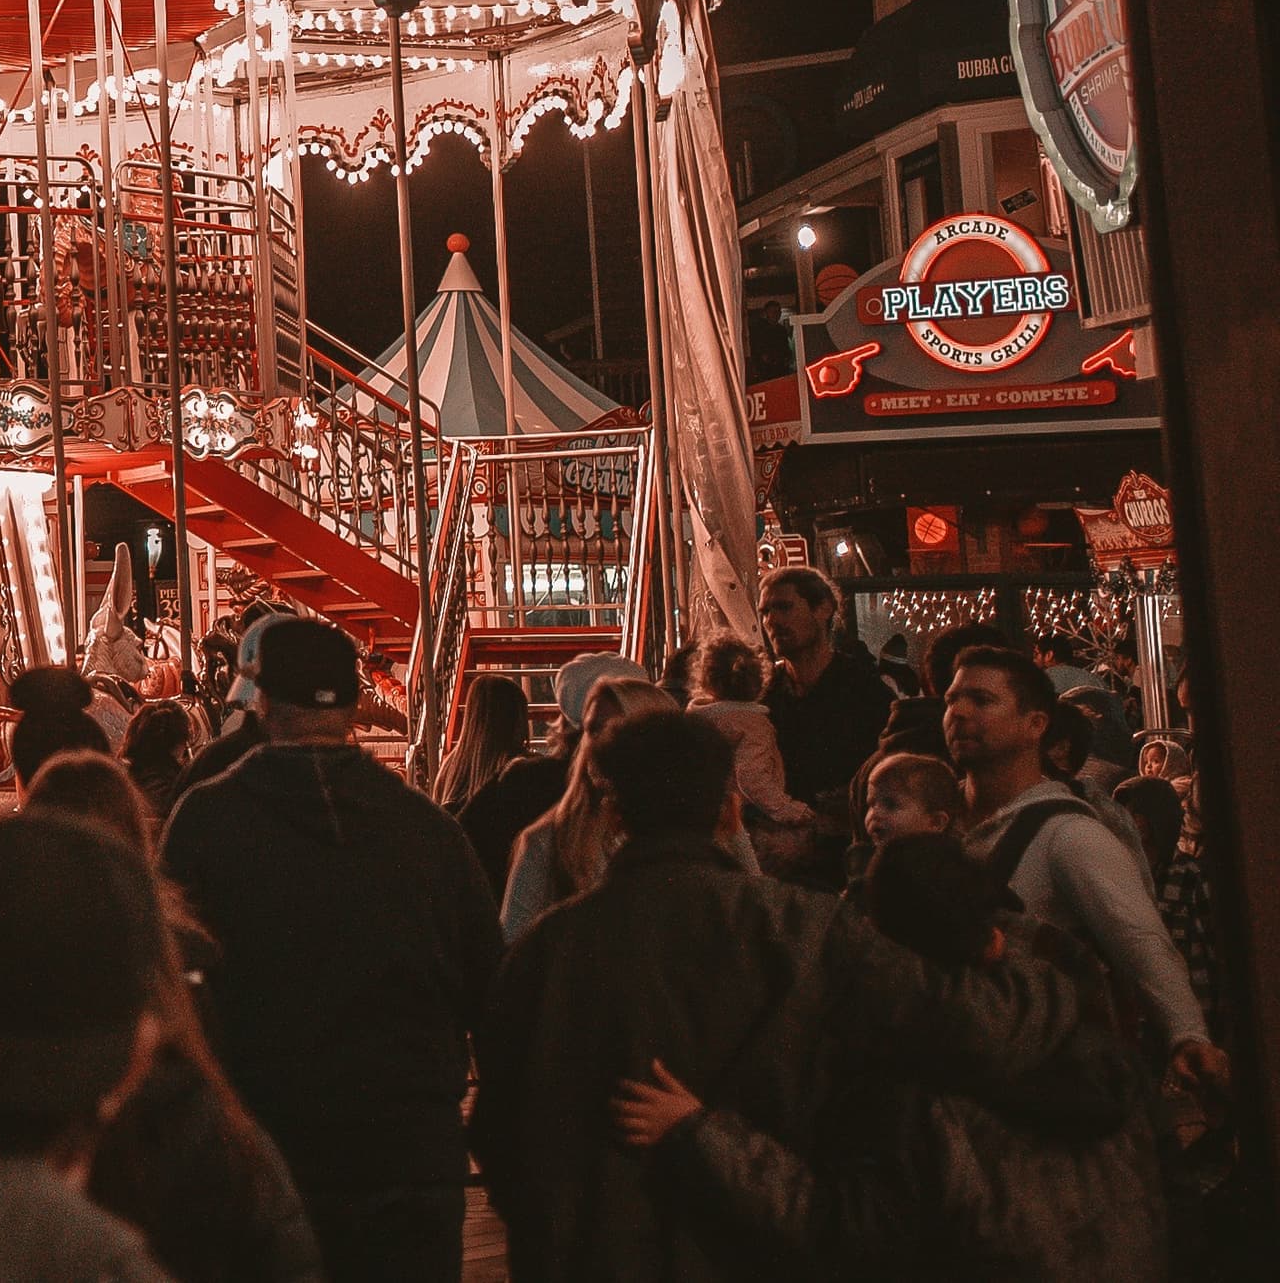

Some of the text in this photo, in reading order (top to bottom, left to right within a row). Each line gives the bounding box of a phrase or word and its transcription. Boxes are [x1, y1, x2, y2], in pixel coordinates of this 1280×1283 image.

[957, 56, 999, 79] BUBBA
[1080, 63, 1120, 105] SHRIMP
[934, 220, 1009, 245] ARCADE
[882, 274, 1069, 322] PLAYERS
[921, 321, 1040, 366] SPORTS GRILL
[881, 386, 1090, 410] MEET EAT COMPETE
[1124, 497, 1171, 528] CHURROS
[160, 589, 177, 599] PIE
